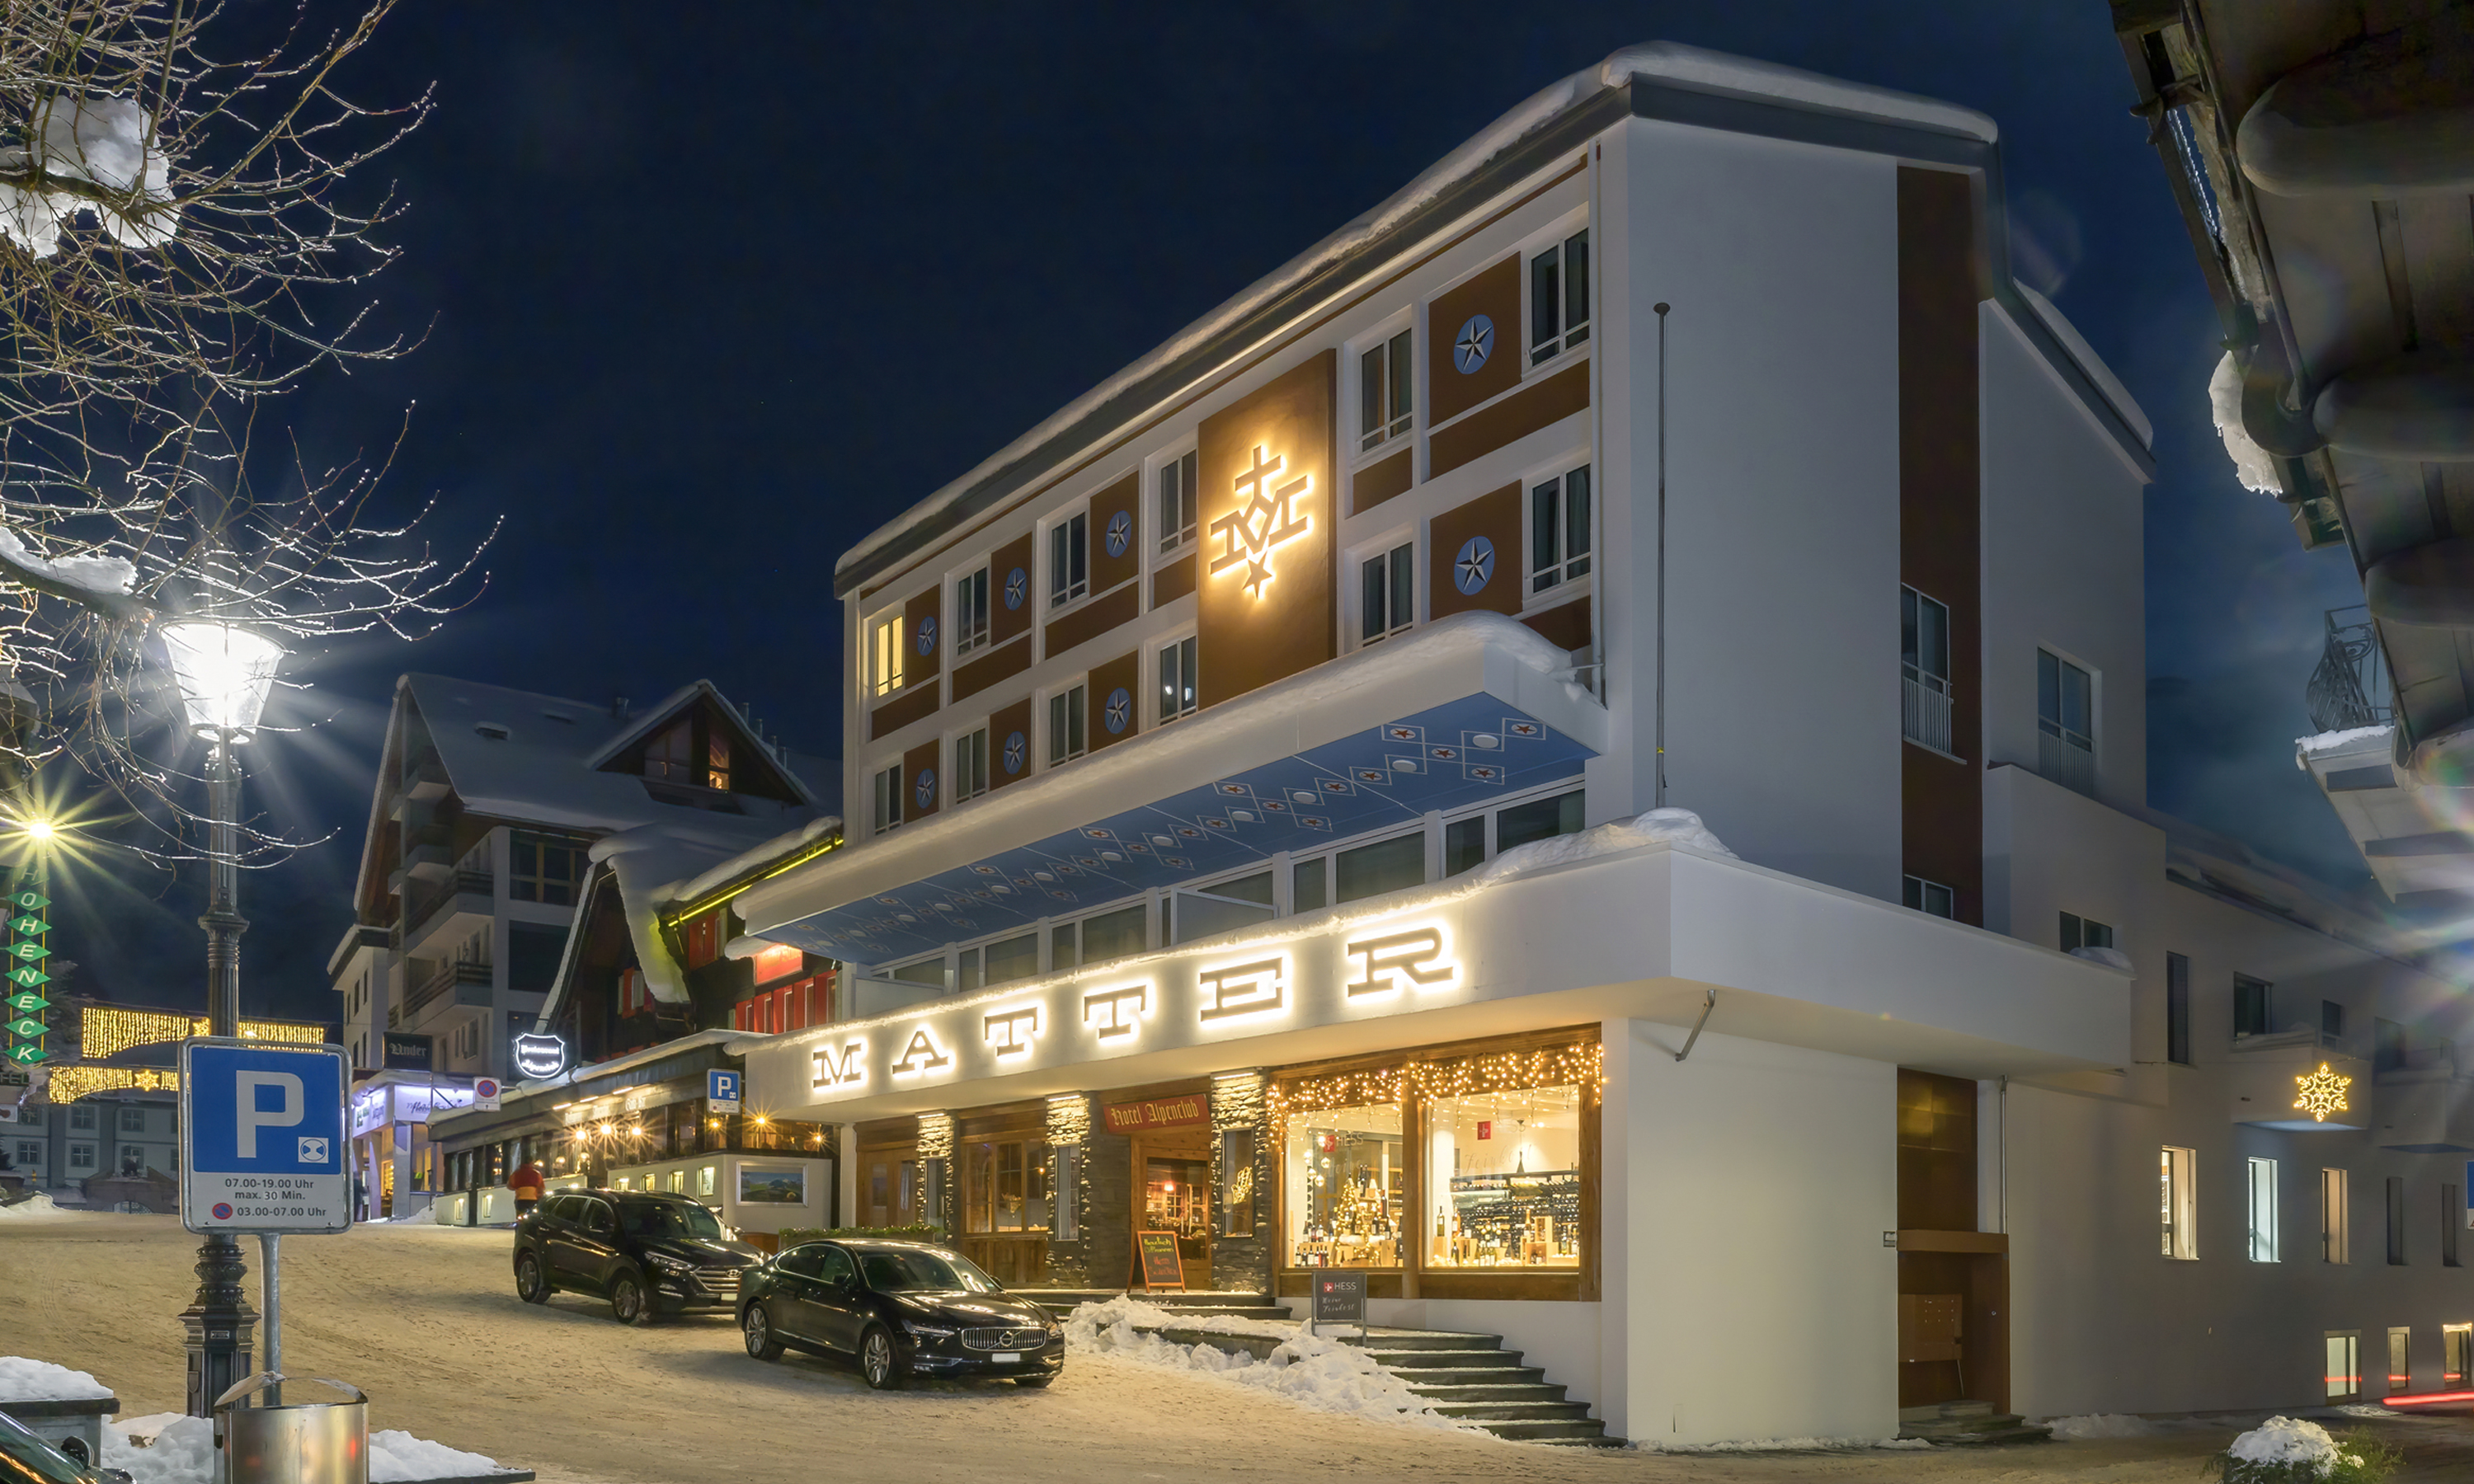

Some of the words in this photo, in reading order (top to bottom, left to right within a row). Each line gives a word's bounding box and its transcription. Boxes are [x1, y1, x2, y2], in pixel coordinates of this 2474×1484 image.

[16, 867, 39, 1061] HOHENECK
[812, 926, 1454, 1089] MATTER
[717, 1076, 732, 1097] P
[236, 1070, 305, 1158] P
[1111, 1106, 1143, 1126] Hotel
[1145, 1099, 1199, 1125] Alpenclub
[1336, 1132, 1364, 1148] HESS
[225, 1178, 291, 1188] 07.00-19.00
[294, 1179, 314, 1189] Uhr
[234, 1191, 262, 1200] max.
[264, 1191, 278, 1200] 30
[281, 1190, 306, 1200] Min.
[237, 1207, 304, 1217] 03.00-07.00
[308, 1207, 327, 1217] Uhr
[1334, 1281, 1357, 1290] HESS
